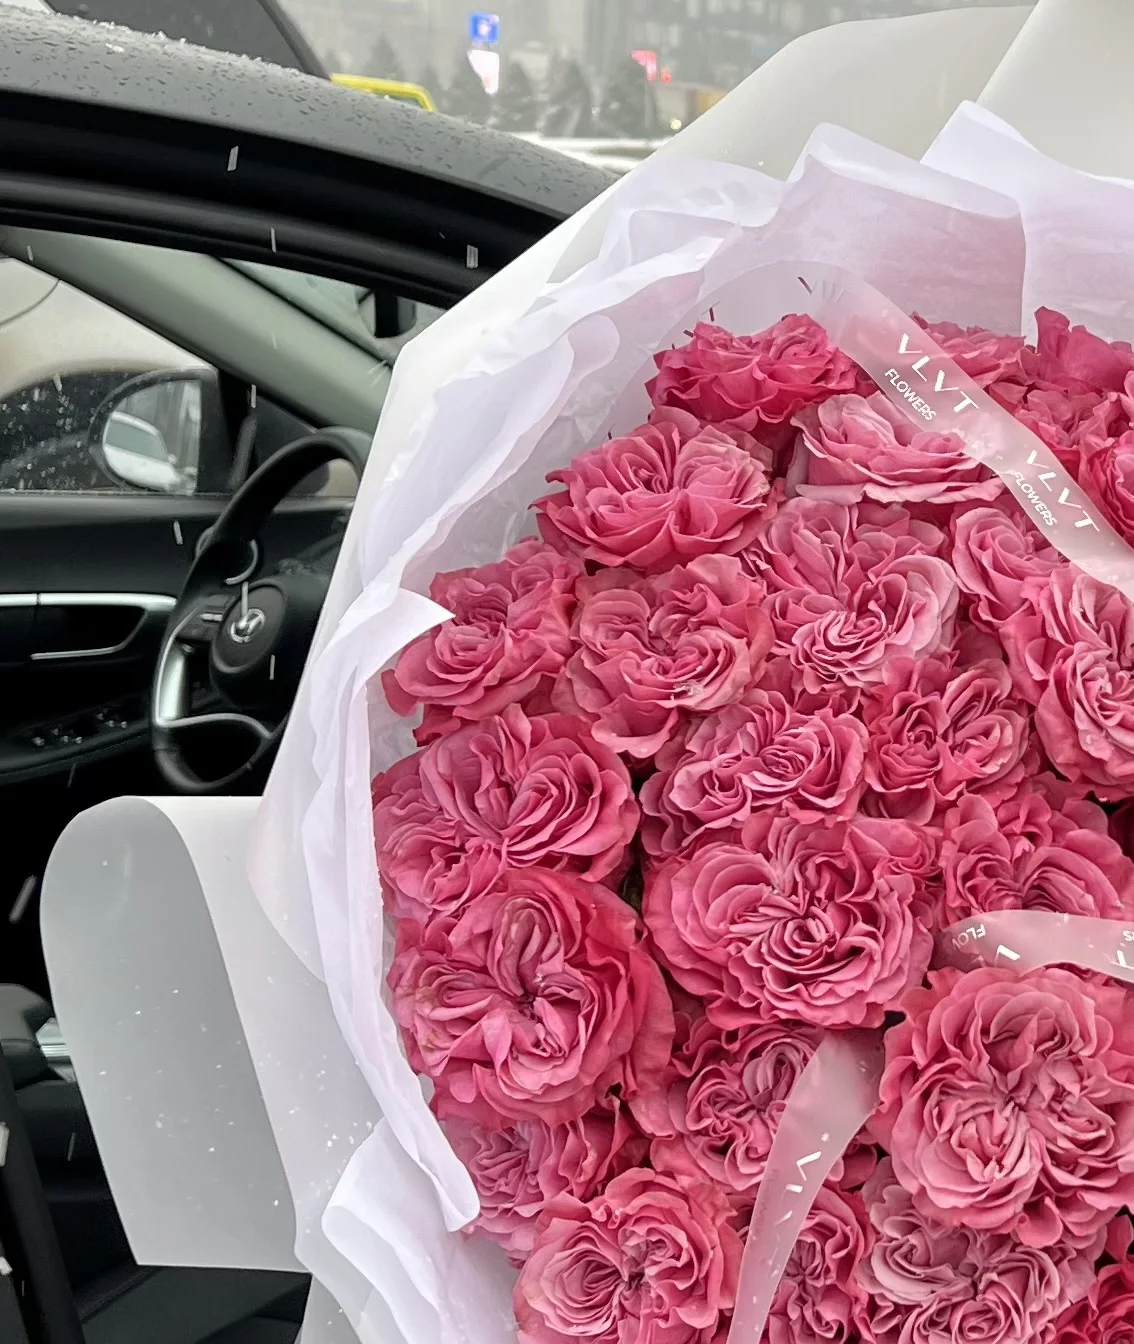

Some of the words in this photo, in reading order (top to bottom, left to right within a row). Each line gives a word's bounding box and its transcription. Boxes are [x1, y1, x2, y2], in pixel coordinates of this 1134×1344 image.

[885, 369, 937, 421] FLOWERS
[898, 333, 979, 413] VLVT
[1010, 469, 1058, 526] FLOWERS
[1026, 449, 1100, 533] VLVT
